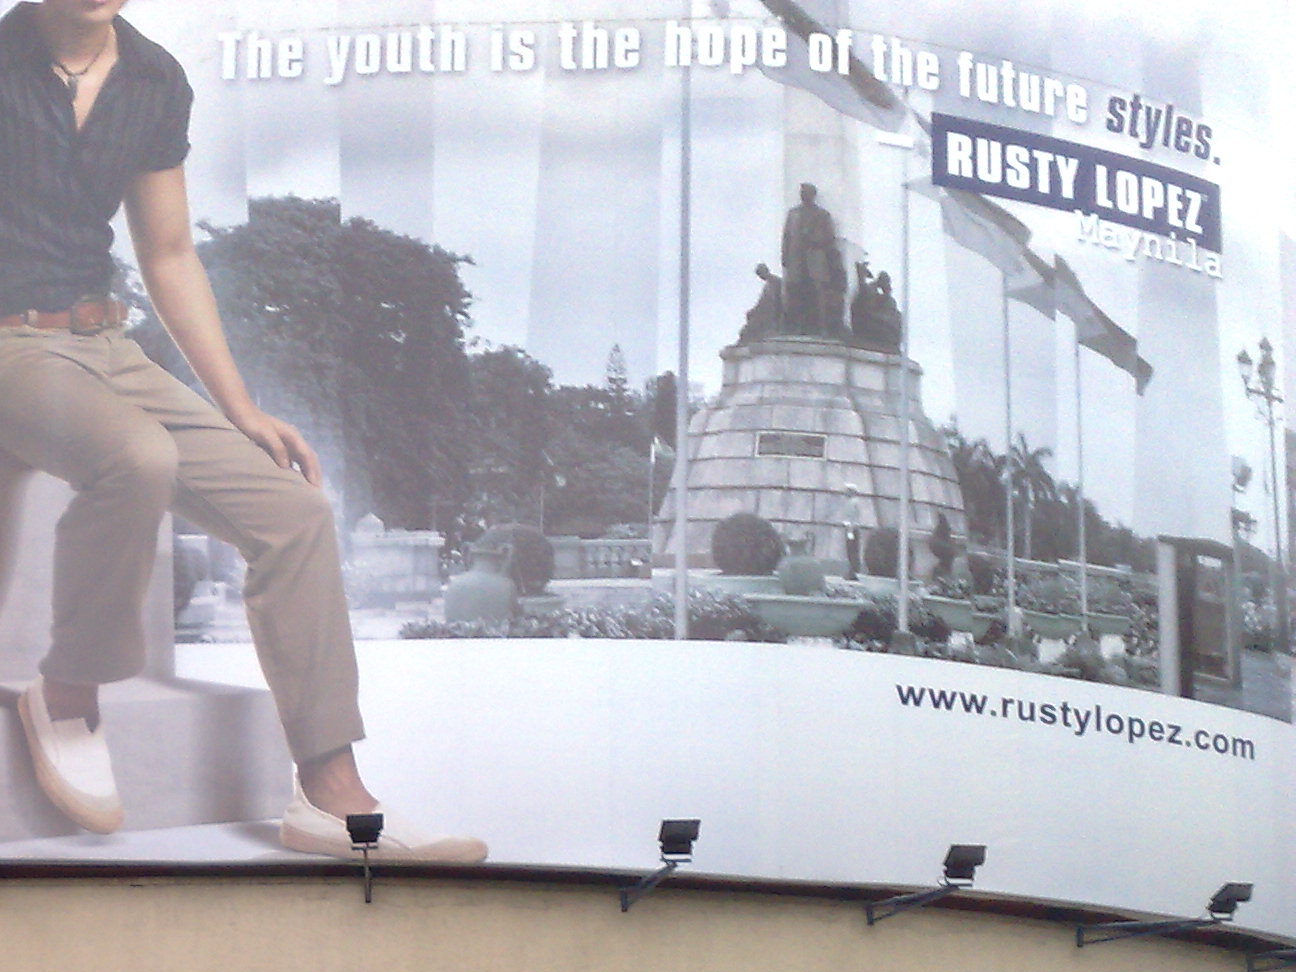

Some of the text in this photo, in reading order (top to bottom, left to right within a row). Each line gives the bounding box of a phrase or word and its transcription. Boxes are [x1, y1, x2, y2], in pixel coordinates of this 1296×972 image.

[218, 20, 1222, 166] The youth is the hope of the future styles.
[946, 130, 1205, 235] RUSTY LOPEZ
[1074, 209, 1223, 280] Maynila
[896, 683, 1257, 760] www.rustylopez.com
